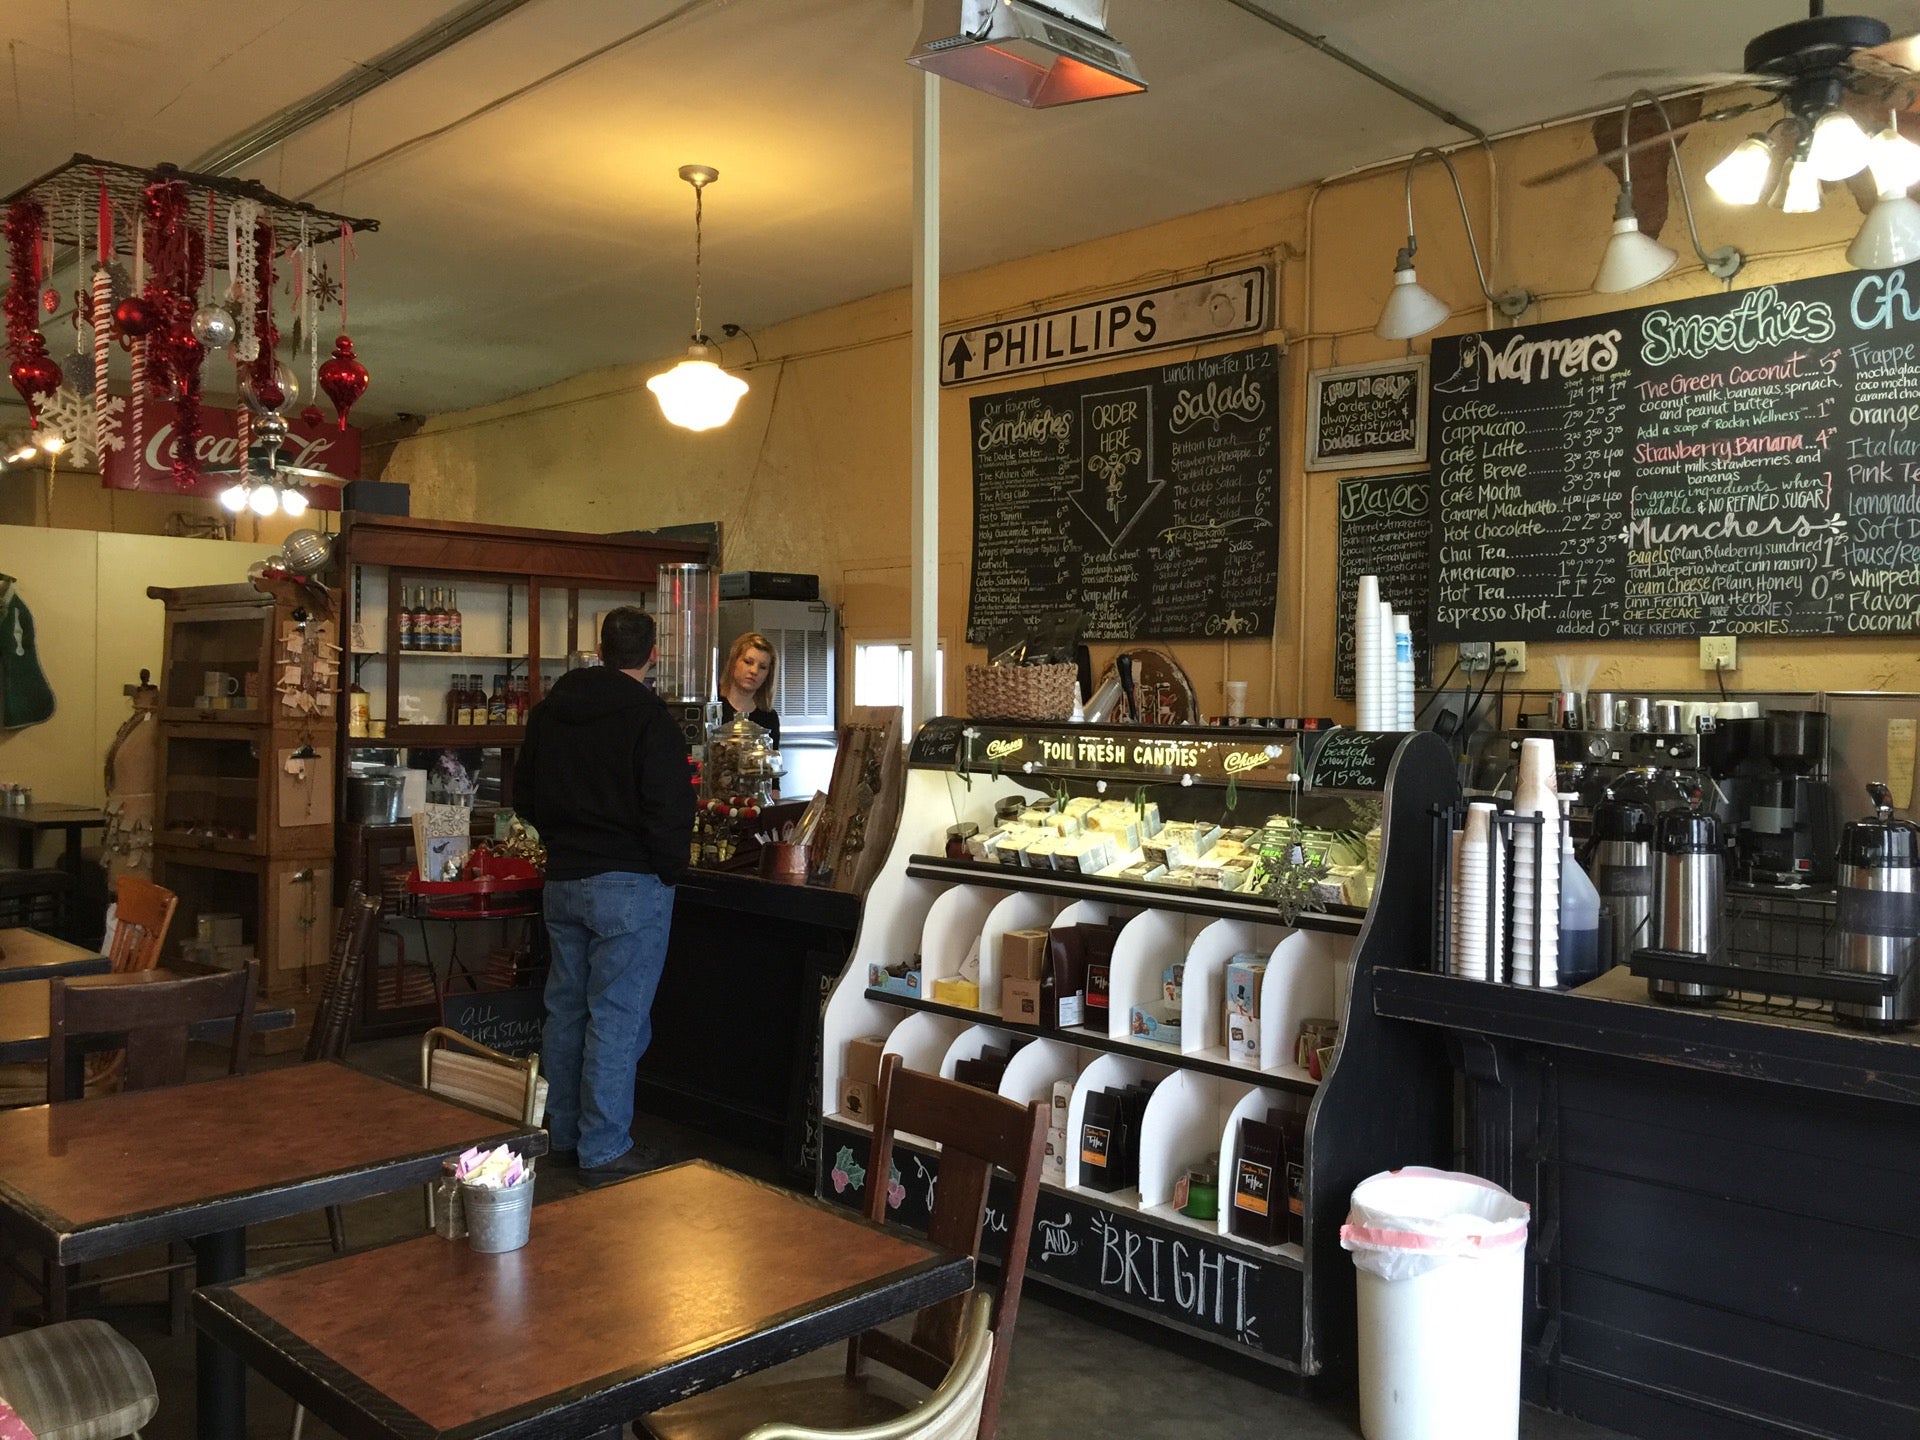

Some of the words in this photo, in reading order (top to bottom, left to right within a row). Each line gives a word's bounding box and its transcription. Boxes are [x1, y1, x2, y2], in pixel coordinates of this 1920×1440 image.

[983, 300, 1157, 371] PHILLIPS
[1243, 278, 1254, 323] 1
[1640, 286, 1836, 366] Smoothies
[1480, 329, 1622, 384] Warmers
[1848, 341, 1916, 371] Frappe
[1162, 362, 1195, 384] Lunch
[1634, 380, 1669, 401] The
[1670, 373, 1723, 395] Green
[1729, 351, 1807, 385] Coconut
[1854, 381, 1879, 392] coco
[1881, 376, 1918, 389] mocha
[1856, 368, 1896, 381] mocha
[1172, 373, 1261, 425] Salads
[1639, 393, 1692, 413] coconut
[1854, 388, 1898, 403] caramel
[1091, 401, 1138, 430] ORDER
[1442, 400, 1500, 422] Coffee
[1659, 405, 1682, 421] and
[1686, 403, 1729, 422] peanut
[1734, 398, 1780, 412] butter
[1849, 403, 1920, 432] Orange
[1321, 425, 1346, 438] very
[1442, 418, 1526, 444] Cappuccino
[1637, 423, 1659, 439] Add
[1662, 426, 1670, 435] a
[1673, 422, 1699, 437] scoop
[1702, 416, 1713, 431] of
[1715, 414, 1750, 429] Rockin
[1100, 426, 1131, 453] HERE
[1207, 433, 1237, 450] Ranch
[1322, 434, 1362, 451] DOUBLE
[1633, 440, 1732, 466] Strawberry
[1735, 434, 1804, 455] Banana
[1440, 445, 1477, 465] Café
[1482, 440, 1528, 459] Latte
[1636, 463, 1681, 477] coconut
[1796, 449, 1821, 464] and
[1440, 465, 1475, 487] Café
[1483, 463, 1528, 480] Breve
[1687, 470, 1741, 486] bananas
[1847, 460, 1894, 484] Pink
[1341, 481, 1430, 520] Flavors
[1440, 486, 1475, 507] Café
[1478, 480, 1522, 503] Mocha
[1634, 487, 1686, 506] organic
[1688, 474, 1778, 500] ingredients
[1781, 473, 1826, 490] when
[1441, 503, 1489, 524] Caramel
[1634, 500, 1696, 517] available
[1708, 496, 1725, 514] NO
[1726, 493, 1780, 513] REFINED
[1782, 488, 1826, 510] SUGAR
[1444, 526, 1470, 542] Hot
[1474, 520, 1546, 539] Chocolate
[1628, 512, 1830, 549] Munchers
[1853, 516, 1904, 543] Soft
[1439, 545, 1472, 564] Chai
[1477, 544, 1506, 560] Tea
[1627, 544, 1670, 567] Bagels
[1765, 533, 1823, 555] sundried
[1438, 565, 1516, 584] Americano
[1744, 558, 1771, 572] cinn
[1624, 578, 1666, 596] Cream
[1667, 577, 1711, 594] Cheese
[1756, 574, 1803, 597] Honey
[1849, 564, 1920, 594] Whipped
[1440, 582, 1470, 603] Hot
[1475, 583, 1506, 600] Tea
[1699, 592, 1724, 606] Van
[1437, 605, 1507, 629] Espresso
[1510, 601, 1551, 623] Shot
[1559, 601, 1593, 620] alone
[1622, 606, 1703, 621] CHEESECAKE
[1734, 601, 1794, 618] SCONES
[1847, 604, 1920, 633] Coconut
[1556, 621, 1594, 634] added
[1623, 623, 1645, 636] RICE
[1649, 622, 1696, 635] KRISPIES
[1726, 619, 1790, 634] COOKIES
[1077, 743, 1126, 764] FRESH
[1318, 755, 1376, 769] snowflake
[1324, 746, 1367, 758] beaded
[1357, 774, 1377, 786] ea
[1241, 1173, 1264, 1191] Toffee
[1044, 1228, 1072, 1254] AND
[1100, 1222, 1261, 1331] BRIGHT
